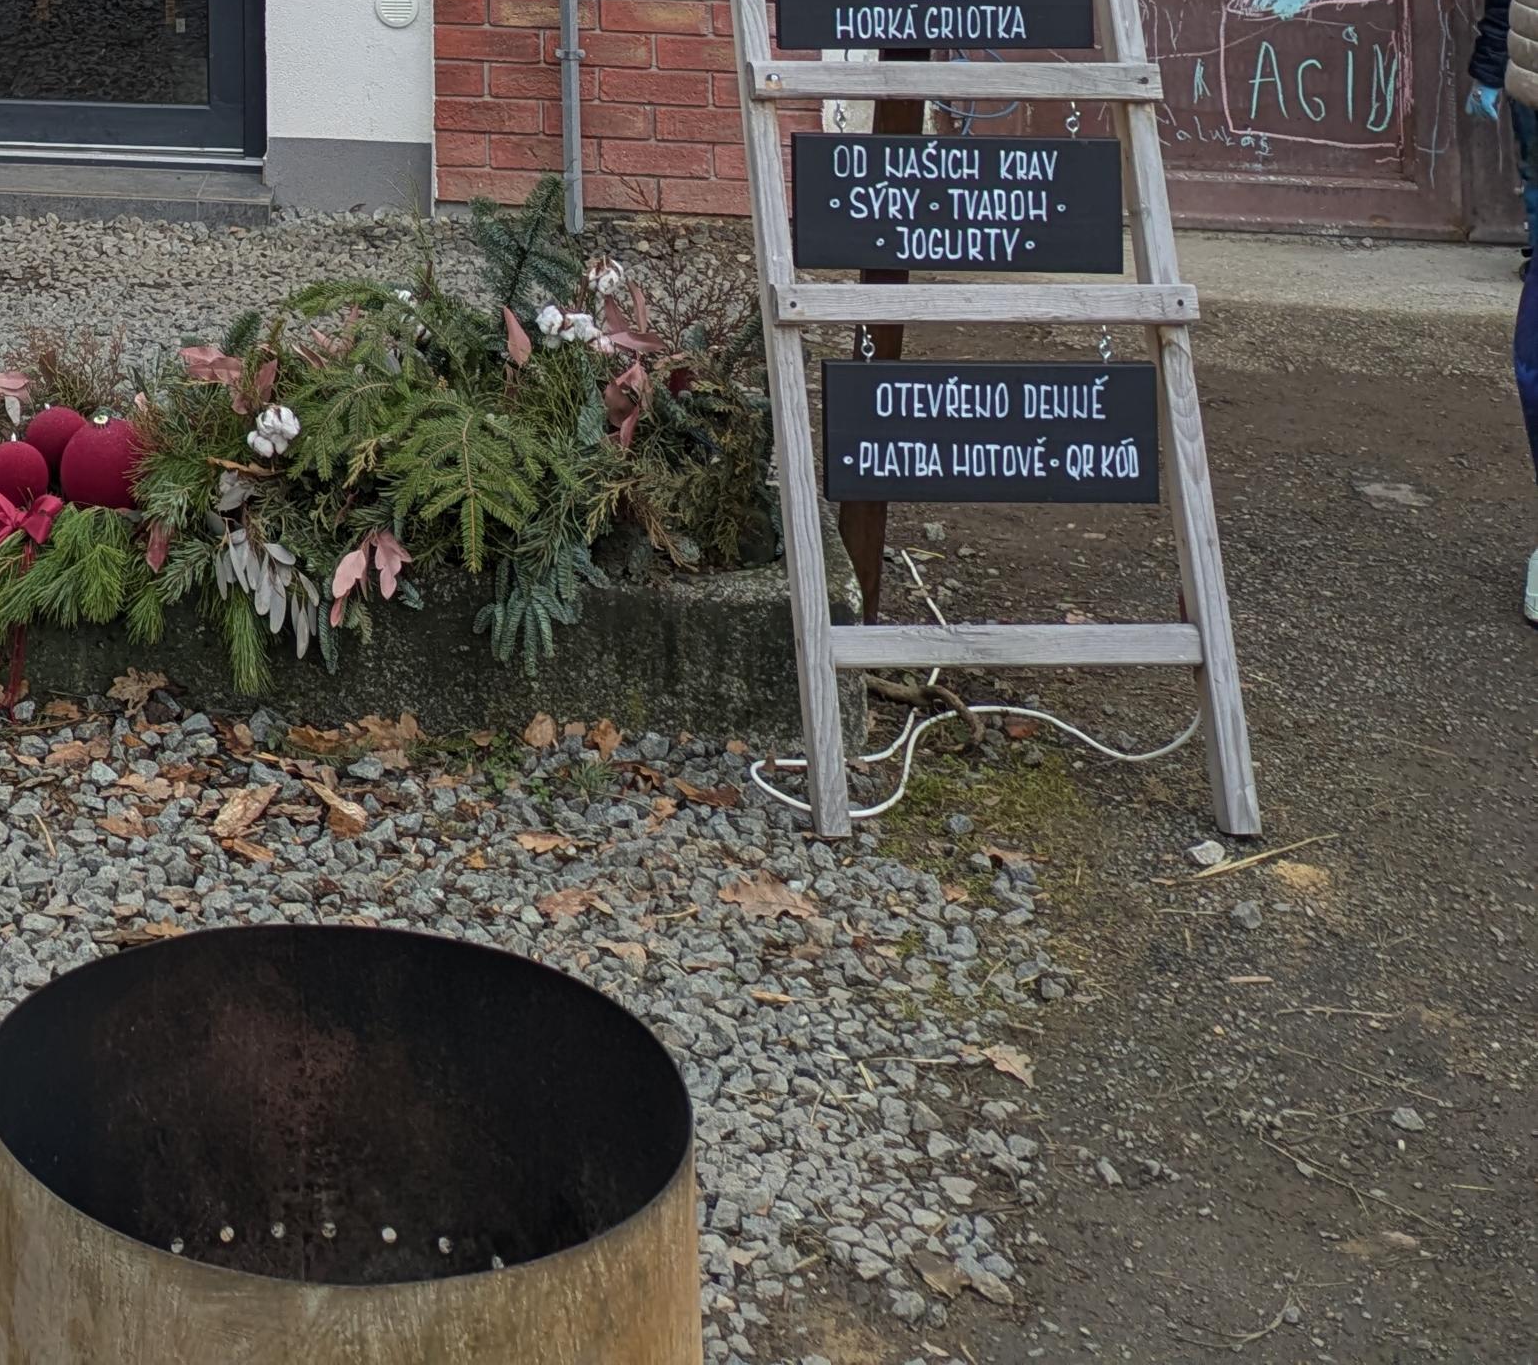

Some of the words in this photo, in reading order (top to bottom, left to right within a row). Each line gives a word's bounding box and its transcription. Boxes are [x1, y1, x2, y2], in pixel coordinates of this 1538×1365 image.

[835, 4, 918, 40] HORKÁ
[924, 5, 1027, 39] GRIOTKA
[833, 145, 868, 178] OD
[885, 140, 979, 180] NAŠICH
[1000, 150, 1058, 181] KRAV
[849, 181, 920, 220] SÝRY
[947, 188, 1048, 222] TVAROH
[895, 226, 1020, 261] JOGURTY
[876, 375, 1009, 418] OTEVŘENO
[1023, 375, 1109, 419] DENNĚ
[858, 441, 944, 478] PLATBA
[952, 436, 1047, 477] HOTOVĚ
[1065, 443, 1095, 481] QR
[1101, 437, 1140, 478] KÓD
